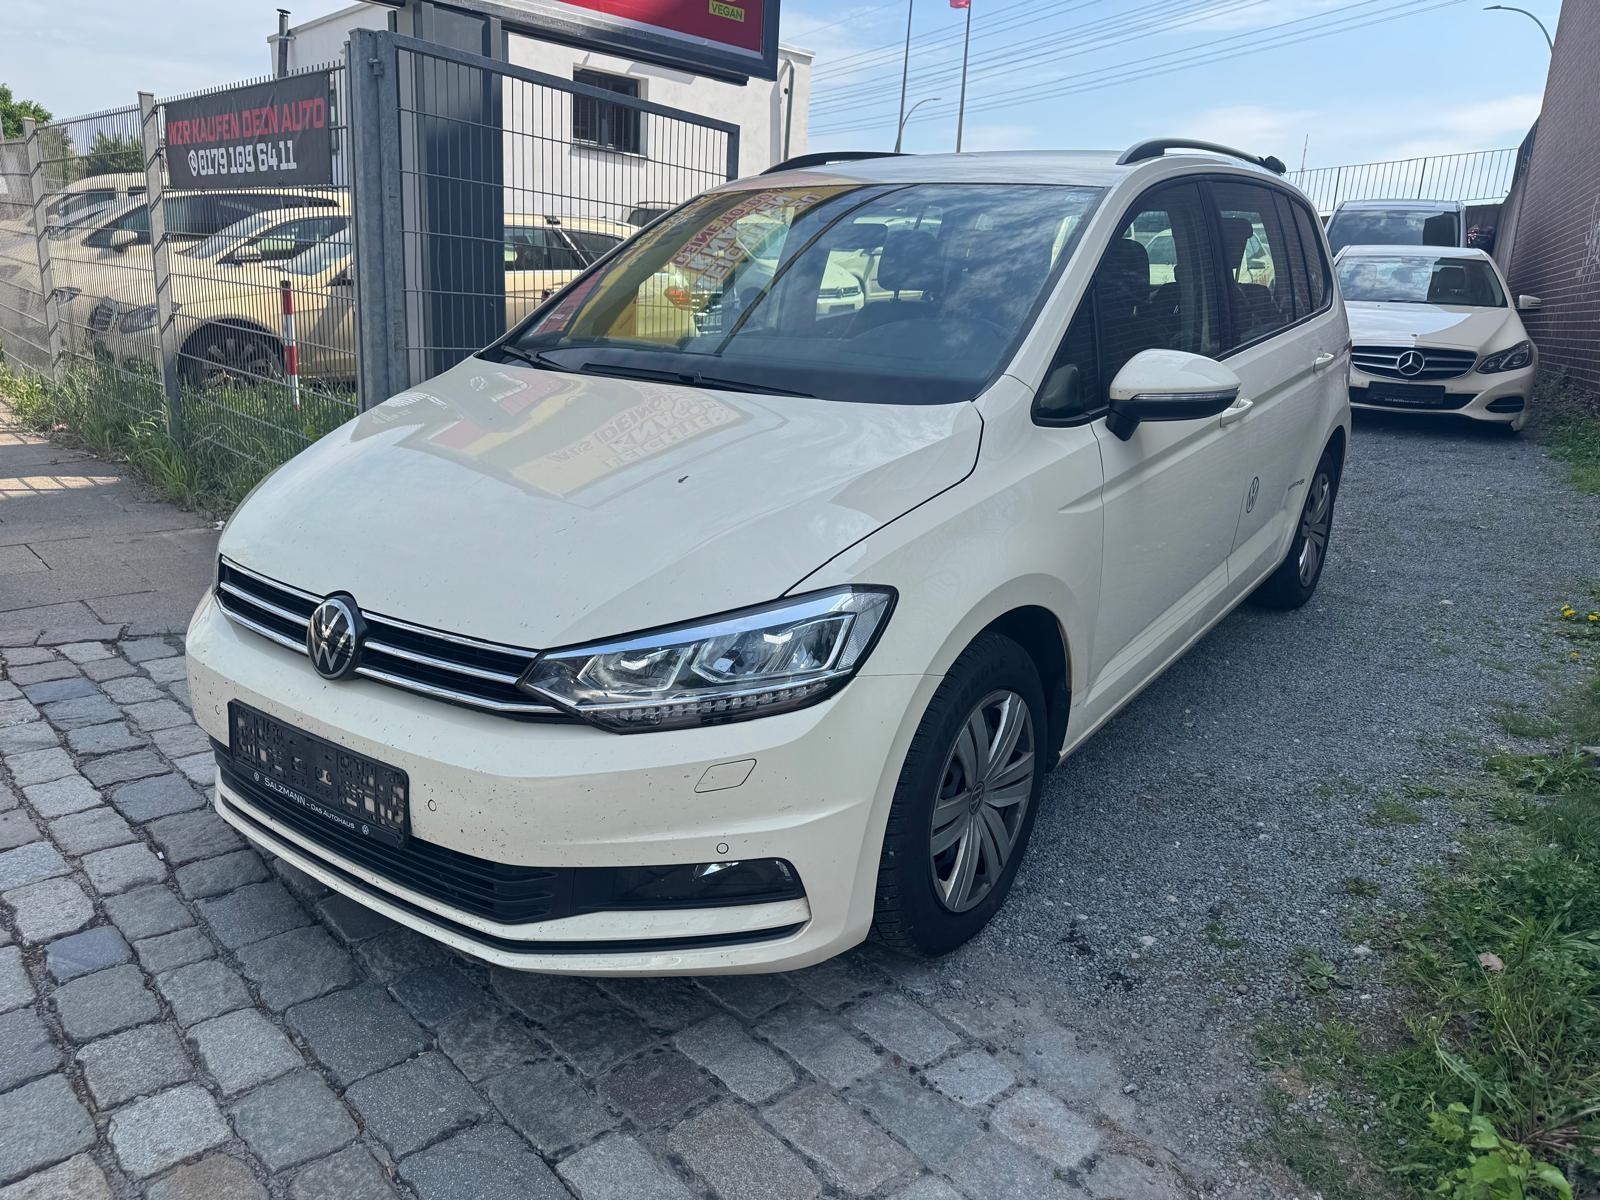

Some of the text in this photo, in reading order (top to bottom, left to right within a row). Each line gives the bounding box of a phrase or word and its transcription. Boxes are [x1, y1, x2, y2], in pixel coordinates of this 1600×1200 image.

[711, 2, 743, 20] VEGAN
[192, 112, 239, 143] KAUFEN
[281, 96, 325, 133] AUTO
[198, 147, 228, 176] 0179
[229, 145, 255, 174] 109
[264, 777, 306, 806] SALZMANN
[310, 803, 323, 815] DAS
[323, 810, 355, 830] AUTOHAUS
